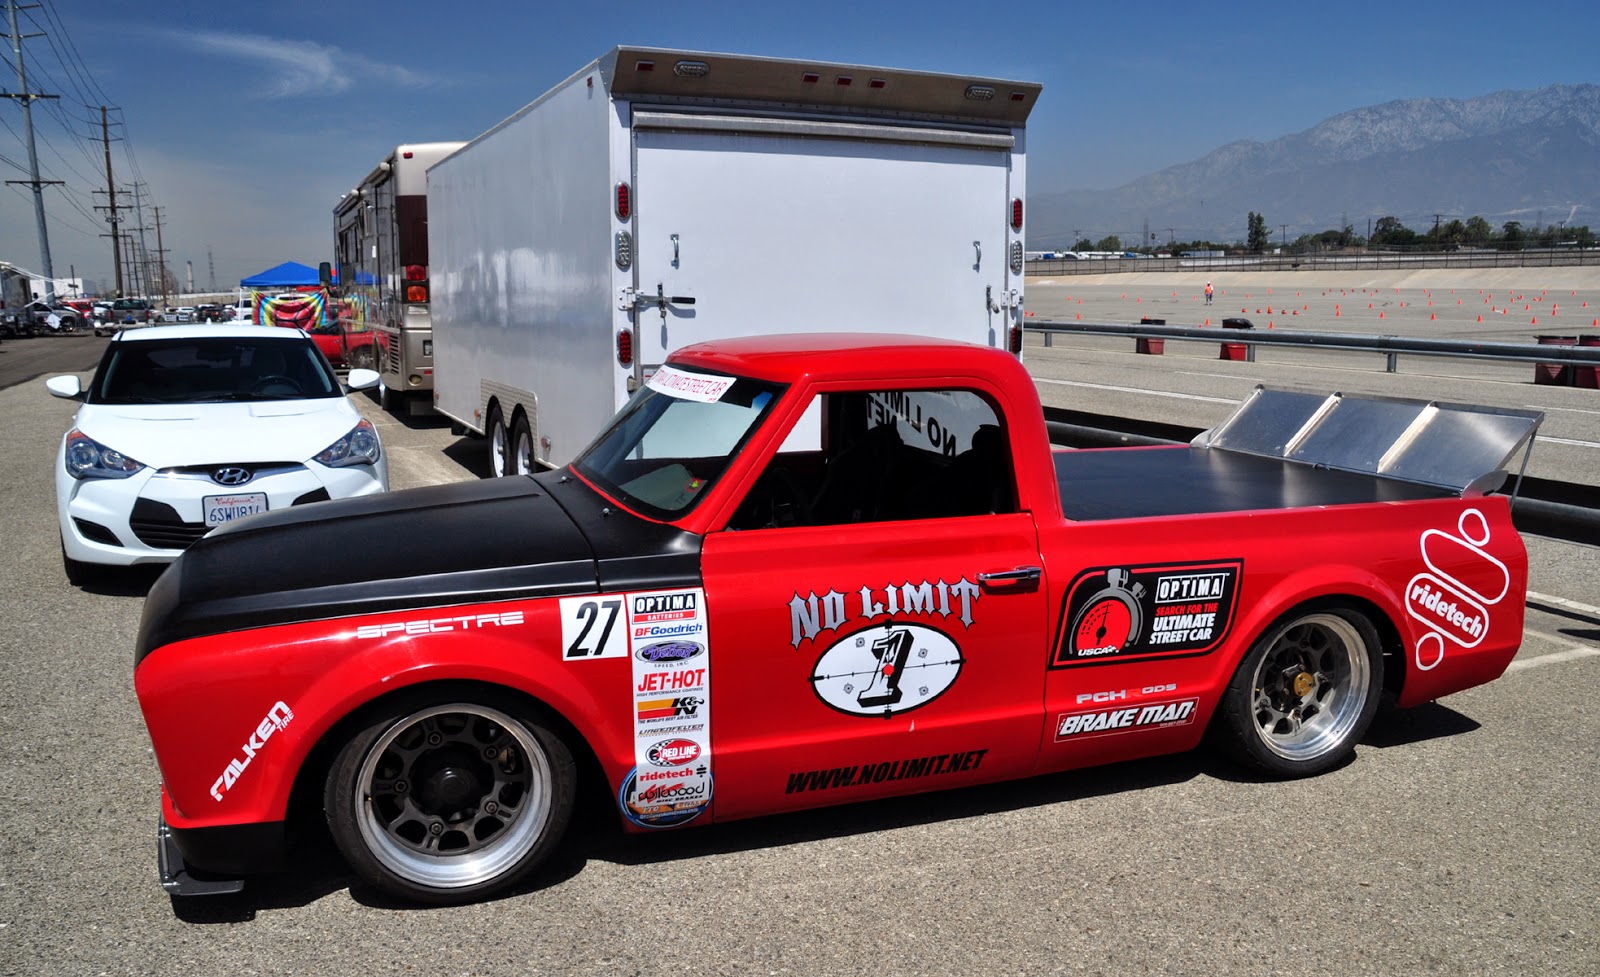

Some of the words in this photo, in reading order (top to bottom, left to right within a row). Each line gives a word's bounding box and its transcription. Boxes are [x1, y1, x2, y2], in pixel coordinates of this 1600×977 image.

[703, 380, 729, 397] CAR
[217, 498, 252, 506] California
[1159, 577, 1222, 600] OPTIMA
[635, 593, 696, 613] OPTIMA
[786, 586, 850, 651] NO
[857, 575, 981, 631] LIMIT
[1155, 604, 1186, 617] SEARCH
[1187, 603, 1203, 615] FOR
[1203, 602, 1219, 614] THE
[1410, 584, 1484, 638] ridetech
[357, 611, 524, 639] SPECTRE
[647, 612, 684, 621] BATTERIES
[1152, 613, 1217, 632] ULTIMATE
[566, 600, 622, 658] 27
[634, 623, 703, 637] BFGoodrich
[1149, 630, 1190, 645] STREET
[1189, 628, 1213, 641] CAR
[637, 668, 706, 692] JET-HOT
[671, 696, 705, 716] K&N
[276, 710, 295, 733] TIRE
[1058, 707, 1140, 736] BRAKE
[209, 700, 291, 803] FALKEN
[661, 747, 678, 758] RED
[679, 745, 698, 756] LINE
[639, 767, 694, 781] ridetech
[784, 749, 990, 795] WWW.NOLIMIT.NET
